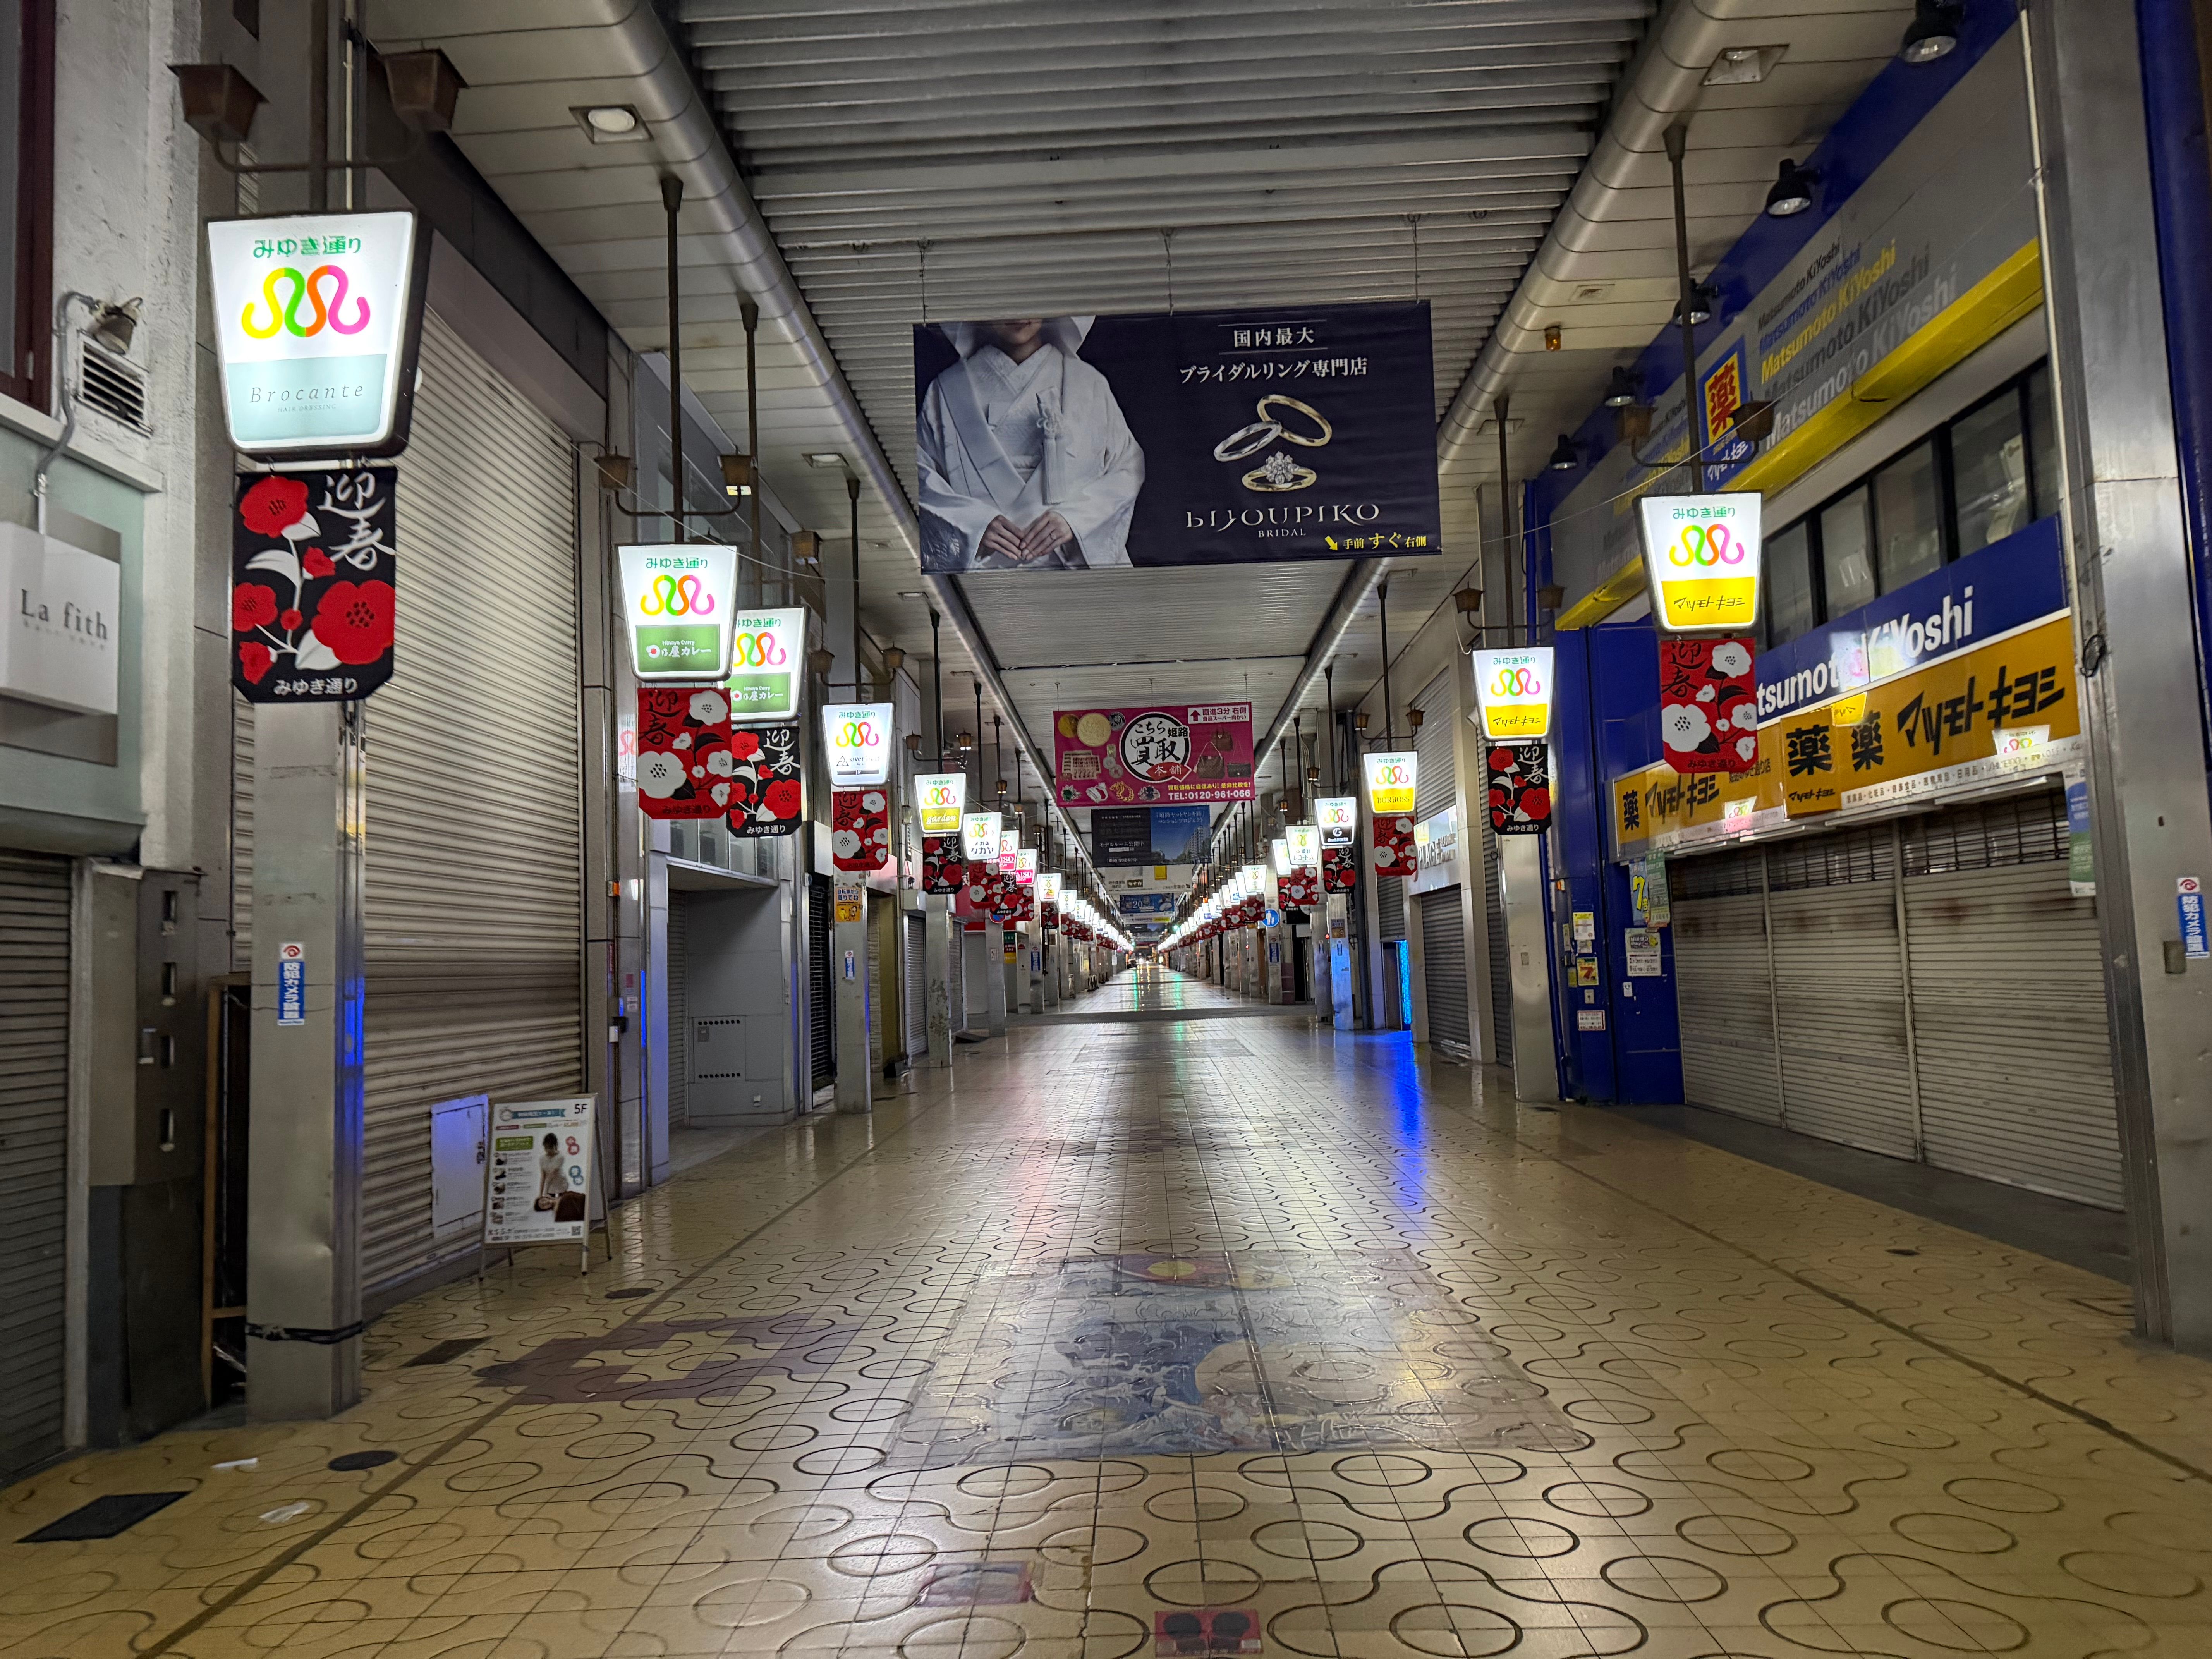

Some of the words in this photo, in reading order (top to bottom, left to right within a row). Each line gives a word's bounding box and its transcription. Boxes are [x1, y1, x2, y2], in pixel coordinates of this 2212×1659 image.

[253, 235, 361, 258] みゆき通り
[1233, 327, 1315, 348] 国内最大
[1762, 303, 1836, 384] Matsumoto
[1180, 357, 1368, 384] ブライダルリング専門店
[250, 385, 363, 403] Brocante
[1708, 361, 1737, 438] 薬
[318, 471, 396, 571] 迎春
[1673, 506, 1736, 519] みゆき通り
[1258, 528, 1307, 538] BRIDAL
[646, 557, 708, 568] みゆき通り
[21, 589, 49, 622] La
[64, 601, 108, 641] fith
[1673, 596, 1746, 611] マツモトキヨシ
[1493, 656, 1536, 665] みゆき通り
[1661, 641, 1705, 698] 迎春
[273, 677, 357, 696] みゆき通り
[1757, 661, 1839, 716] tsumot
[638, 690, 683, 745] 迎春
[1493, 716, 1541, 726] マツモトキヨシ
[1897, 665, 2066, 756] マツモトキヨシ
[1135, 721, 1166, 735] こちら
[1168, 727, 1188, 738] 姫路
[763, 728, 800, 775] 迎春
[1130, 736, 1181, 766] 買取
[1786, 724, 1833, 776] 薬
[1851, 710, 1884, 773] 薬
[1154, 765, 1182, 776] 本舗
[1518, 746, 1549, 784] 迎春
[1687, 758, 1736, 769] みゆき通り
[1645, 773, 1720, 824] マツモトキヨシ
[1789, 788, 1836, 803] マツモトキヨシ
[926, 813, 956, 825] garden
[1623, 790, 1640, 831] 薬
[747, 825, 786, 834] みゆき通り
[1506, 824, 1539, 832] みゆき通り
[942, 837, 961, 862] 迎春
